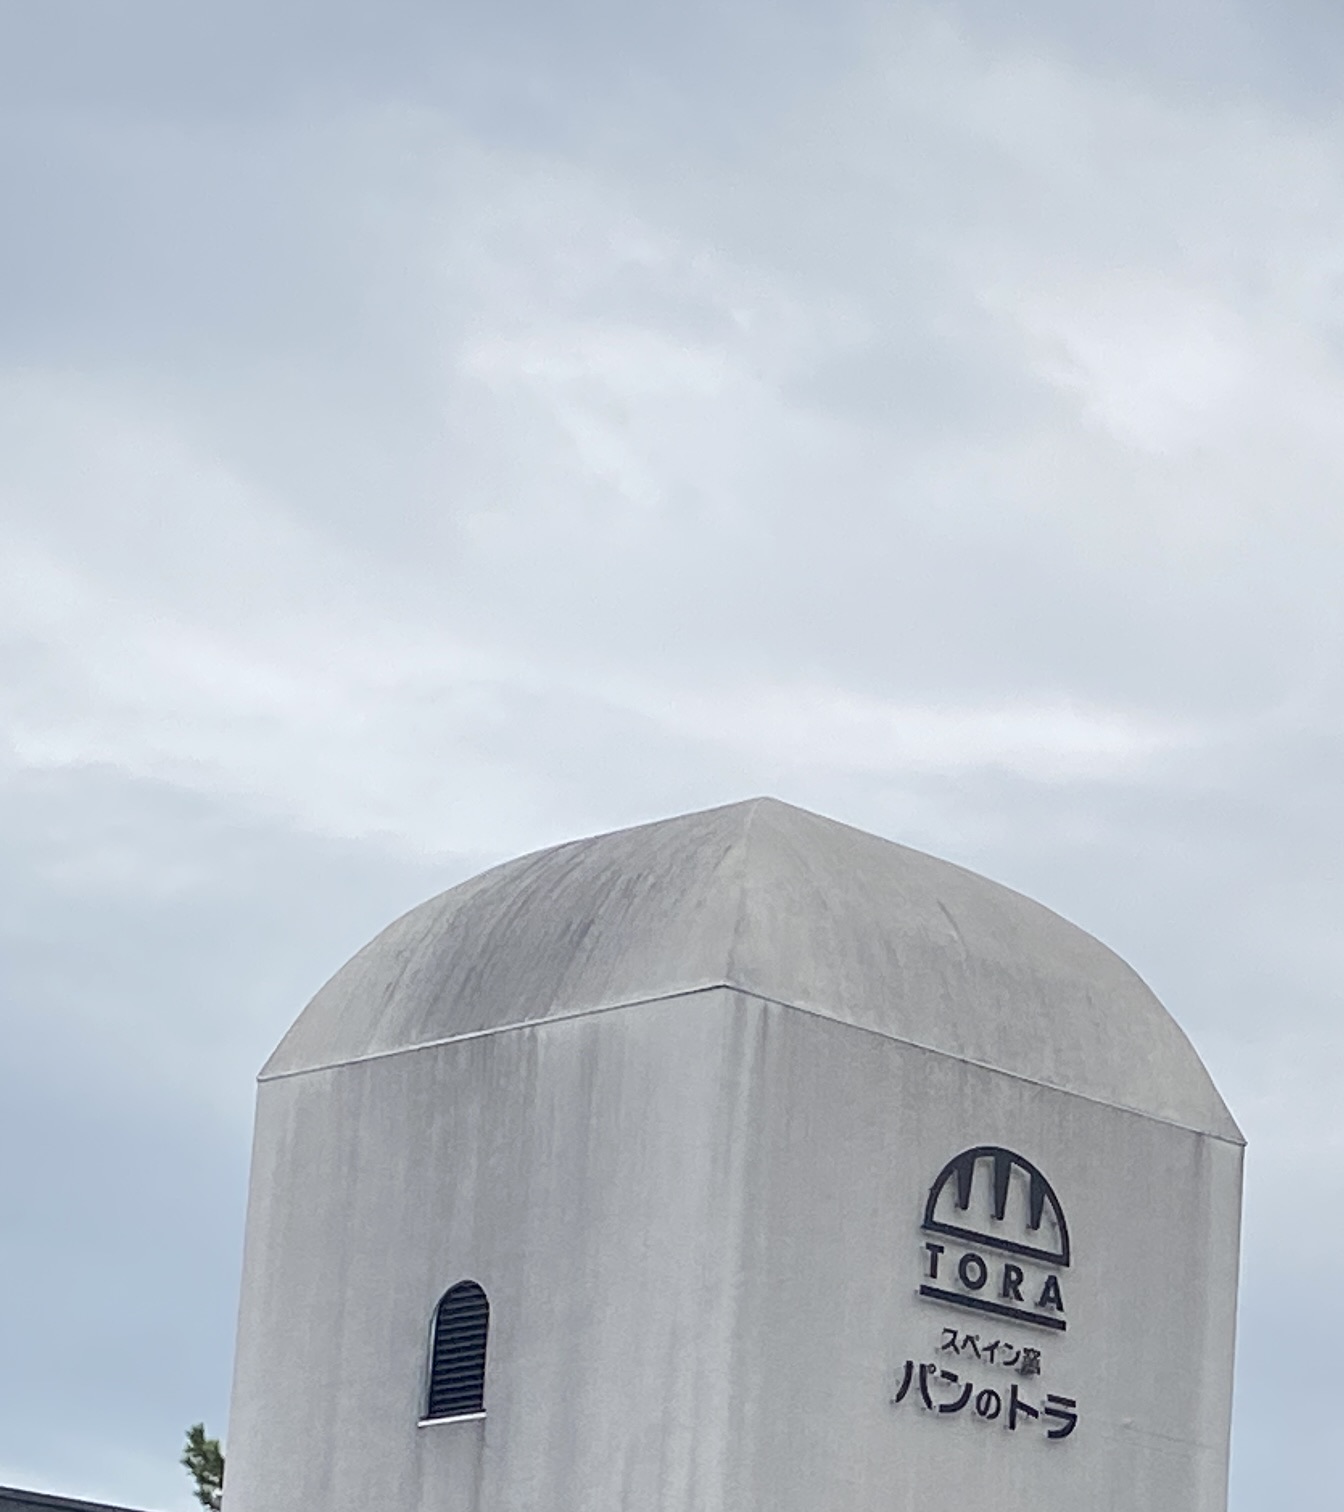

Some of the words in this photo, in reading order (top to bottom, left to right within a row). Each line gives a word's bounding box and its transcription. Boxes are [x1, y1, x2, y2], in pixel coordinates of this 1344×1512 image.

[925, 1243, 1064, 1312] TORA
[896, 1360, 1078, 1439] パンのトラ
